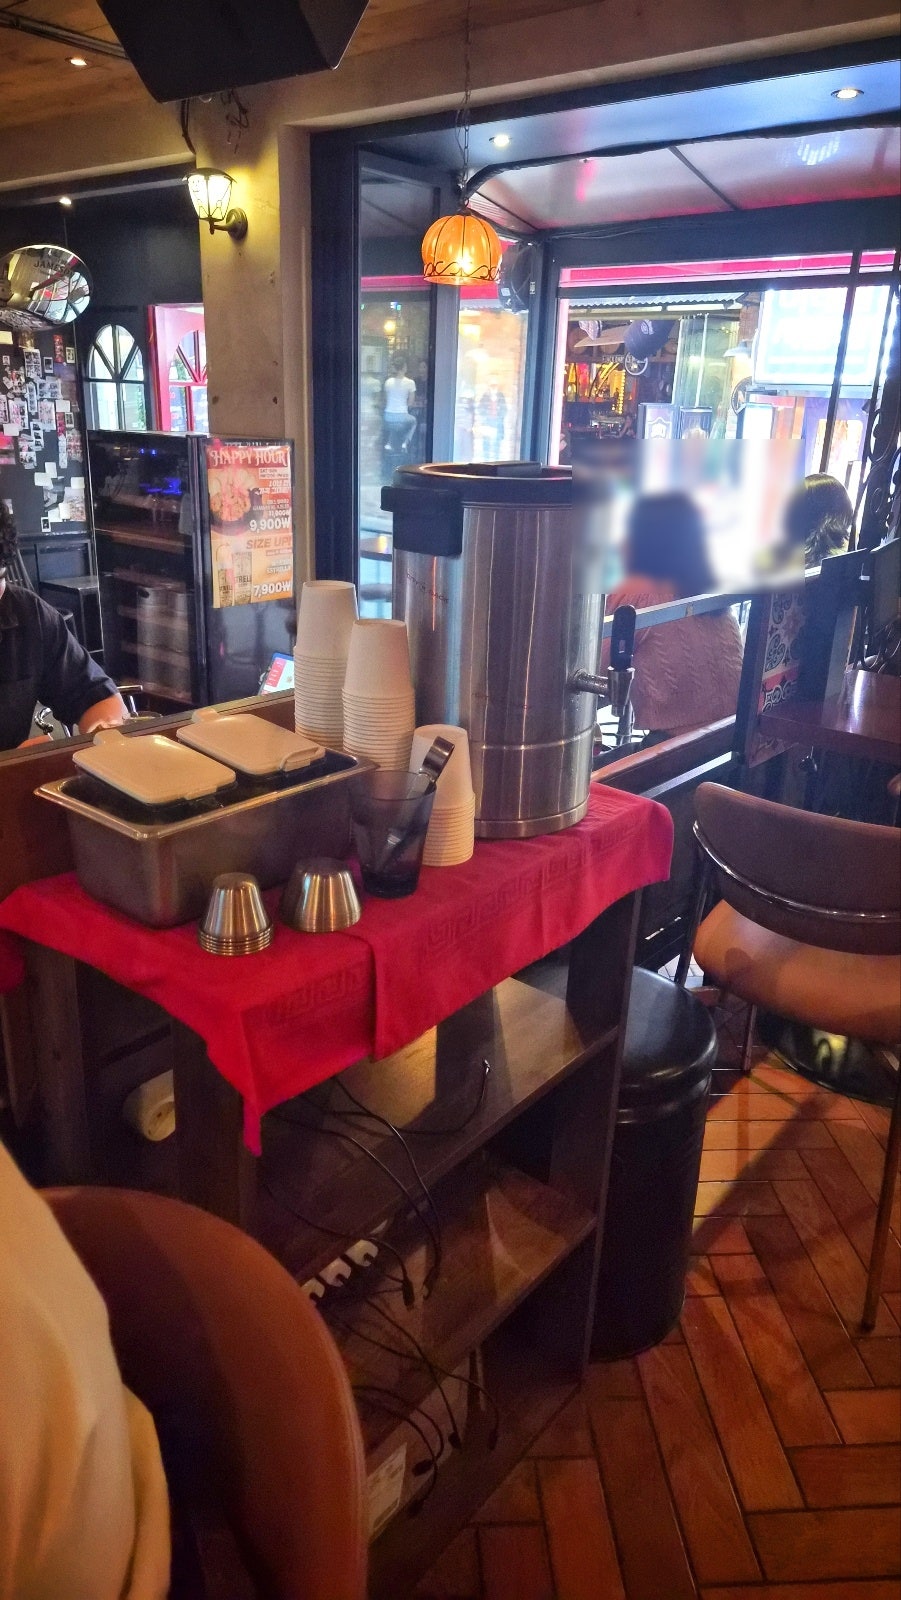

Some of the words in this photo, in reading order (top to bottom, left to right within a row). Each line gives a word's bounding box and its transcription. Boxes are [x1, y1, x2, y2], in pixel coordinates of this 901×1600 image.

[211, 448, 253, 467] HAPPY
[255, 449, 288, 467] HOUR
[246, 538, 272, 549] SIZE
